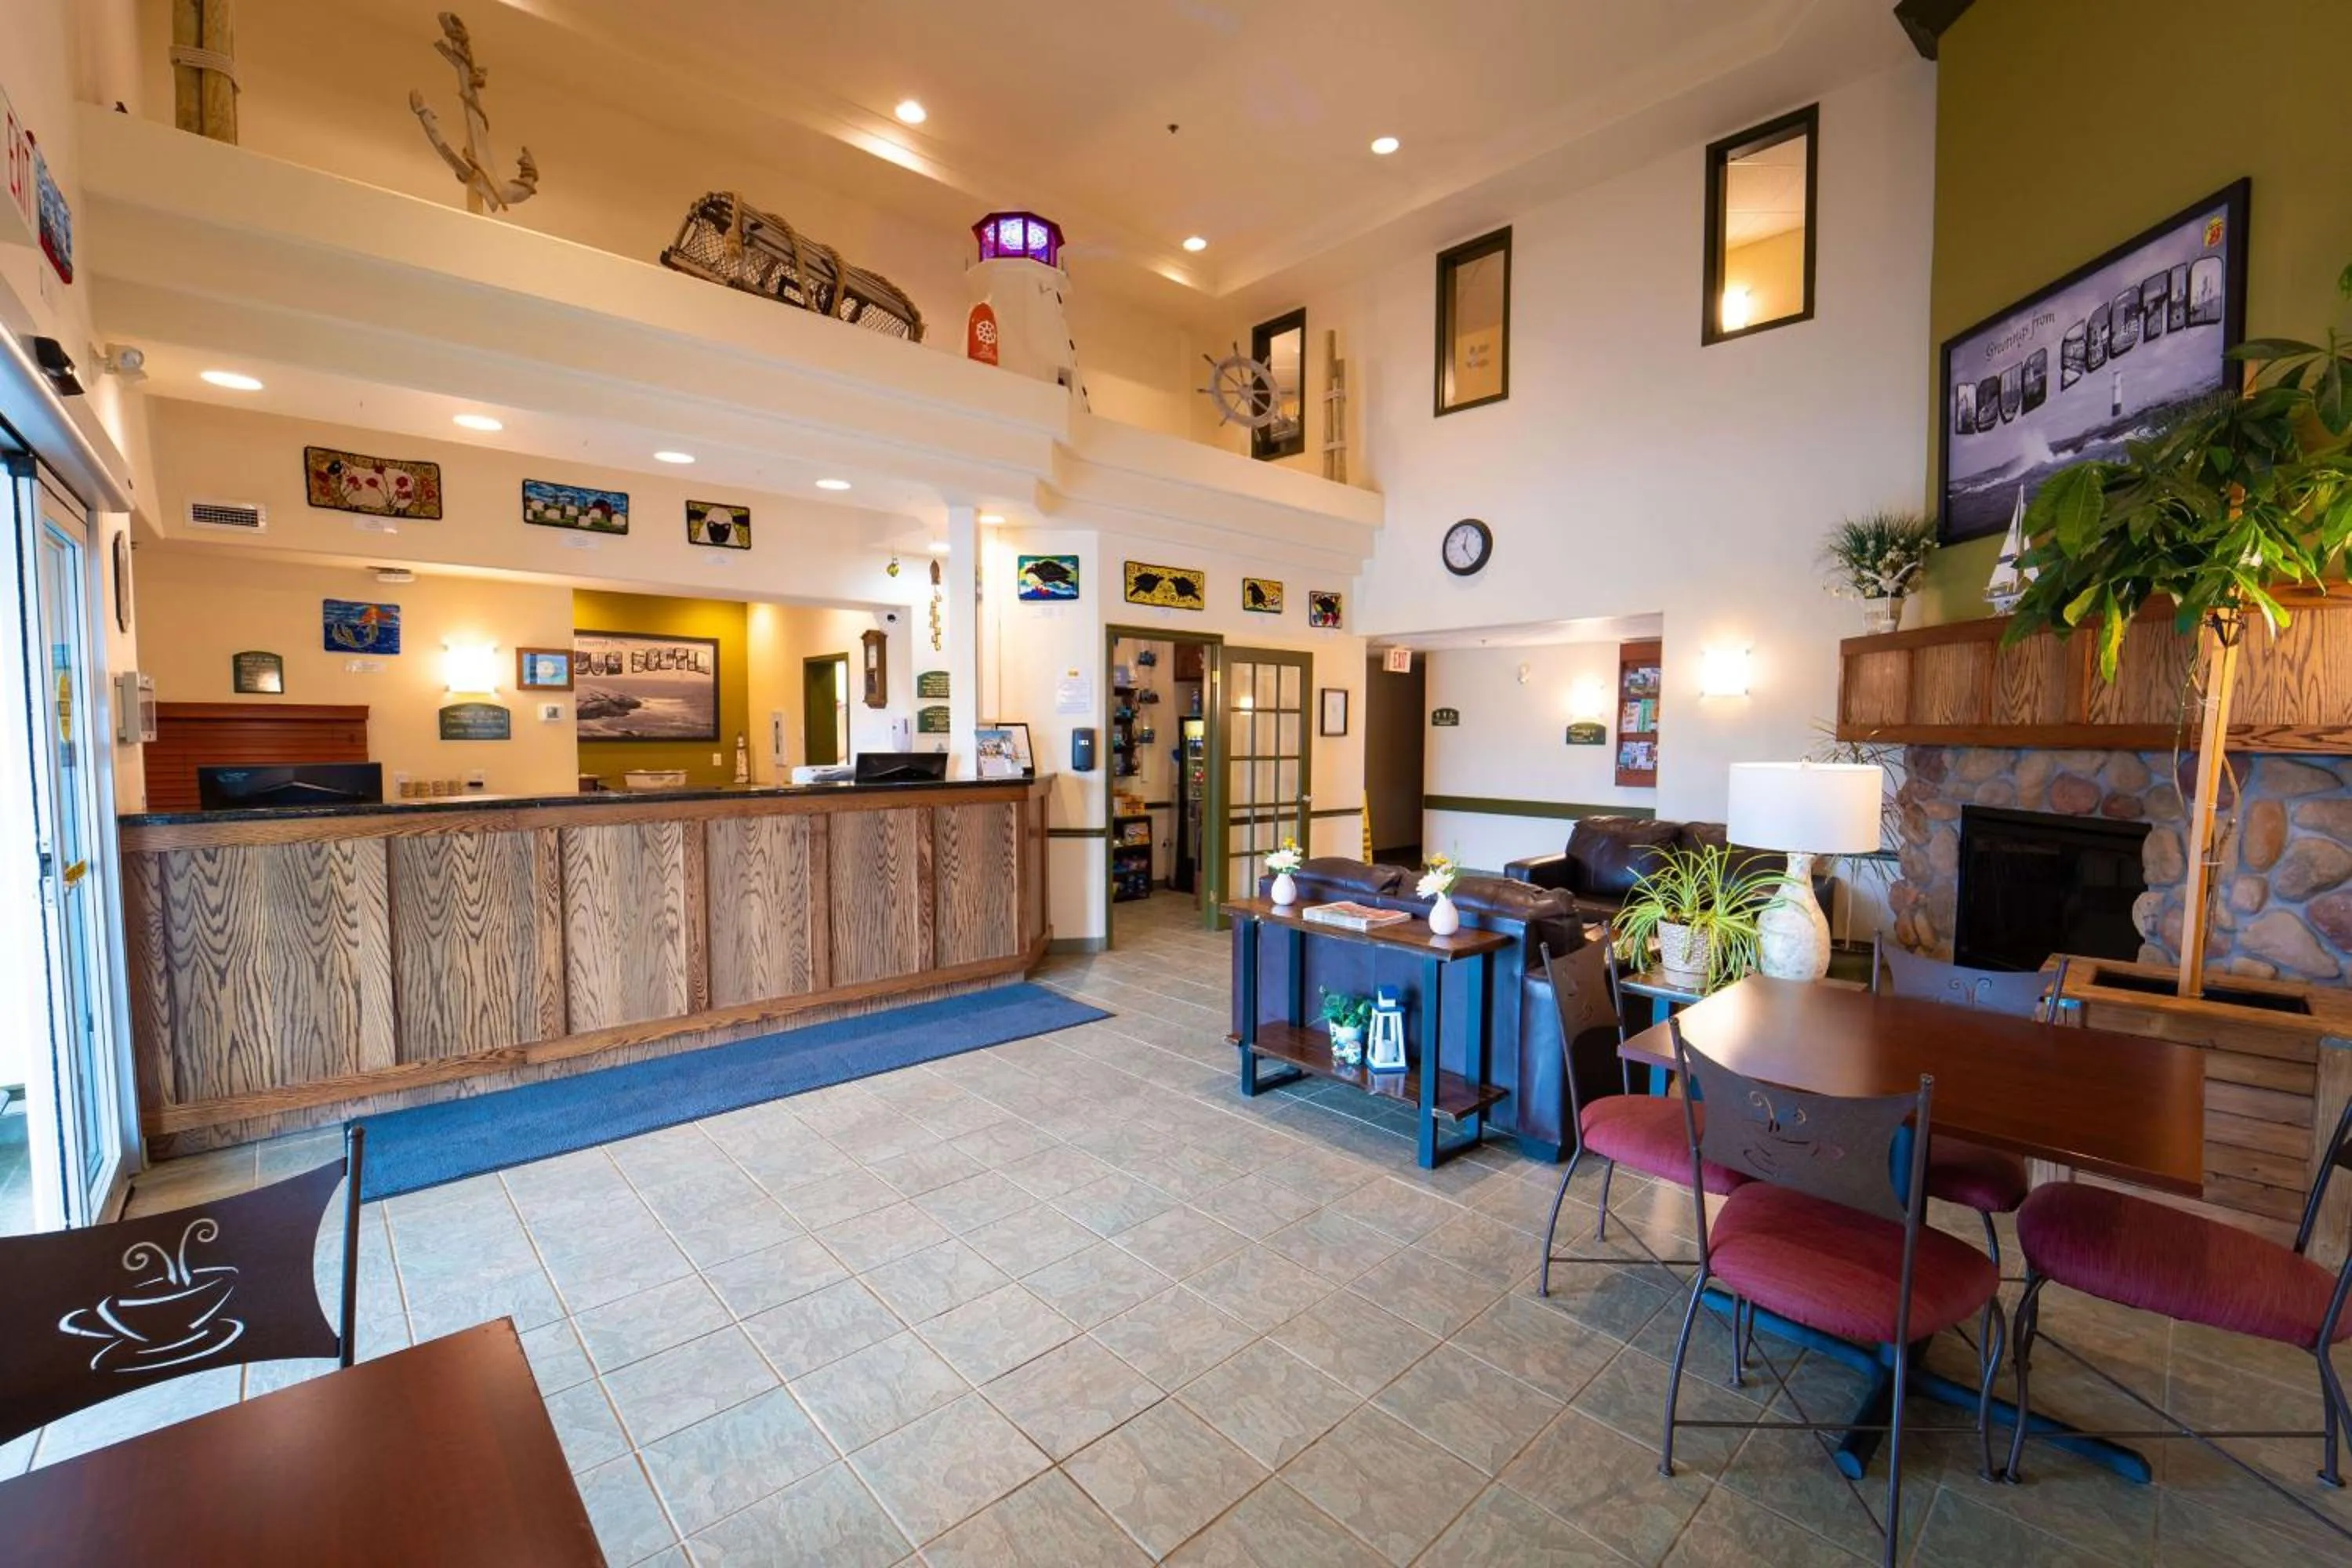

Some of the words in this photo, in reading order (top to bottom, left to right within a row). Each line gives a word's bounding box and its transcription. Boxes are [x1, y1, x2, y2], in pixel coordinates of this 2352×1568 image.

[7, 112, 31, 225] EXIT
[2028, 310, 2056, 340] from
[1955, 347, 2048, 435] NOVA
[2060, 256, 2224, 392] SCOTIA
[575, 650, 623, 676] OVA
[631, 648, 711, 674] SCOTIA
[1392, 652, 1406, 669] EXIT
